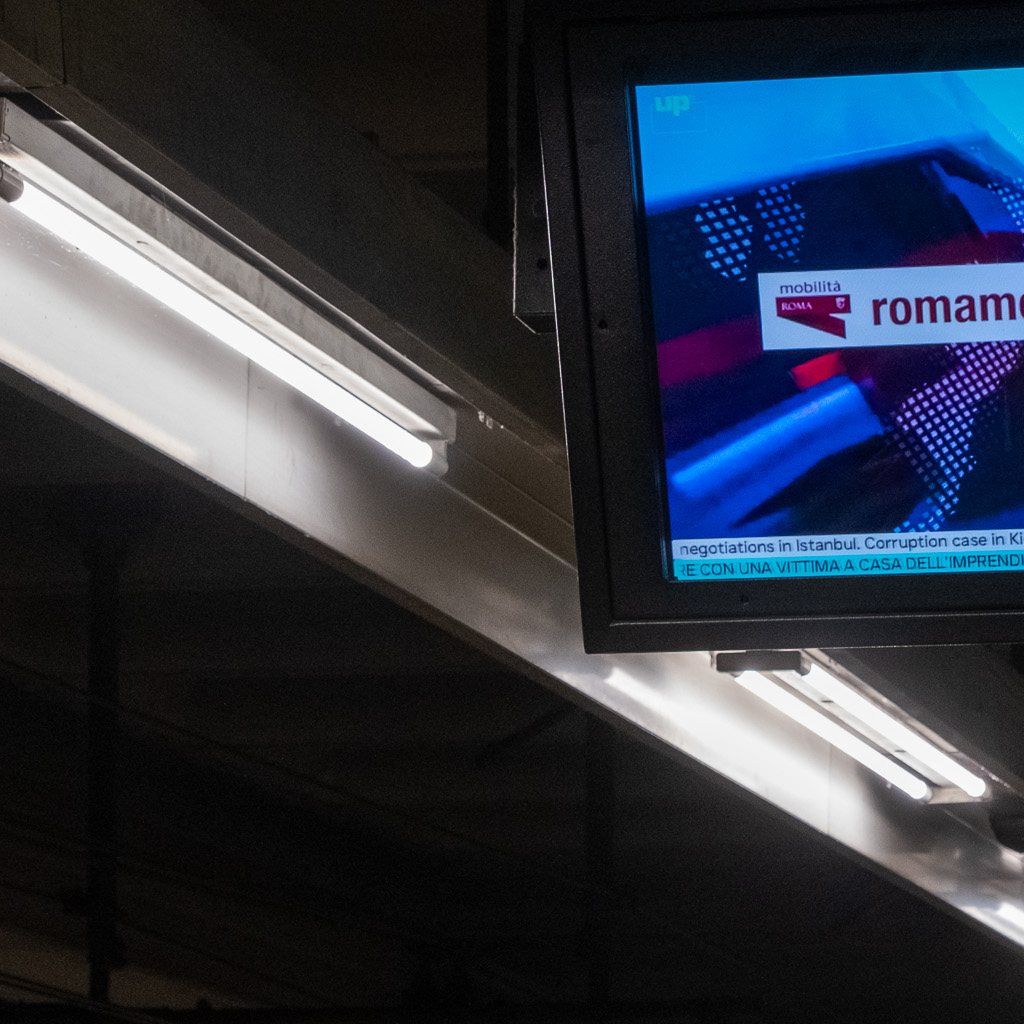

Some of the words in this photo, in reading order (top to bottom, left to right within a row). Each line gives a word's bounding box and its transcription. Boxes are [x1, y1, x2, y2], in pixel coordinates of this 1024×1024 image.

[655, 95, 690, 117] up
[780, 280, 841, 294] mobilità
[781, 302, 813, 312] ROMA
[680, 536, 775, 558] negotiations
[778, 537, 792, 553] in
[796, 534, 860, 552] Istanbul.
[864, 533, 948, 554] Corruption
[951, 535, 988, 548] case
[991, 532, 1005, 547] in
[700, 560, 735, 577] CON
[740, 558, 772, 575] UNA
[776, 556, 840, 575] VITTIMA
[843, 557, 856, 572] A
[858, 554, 902, 573] CASA
